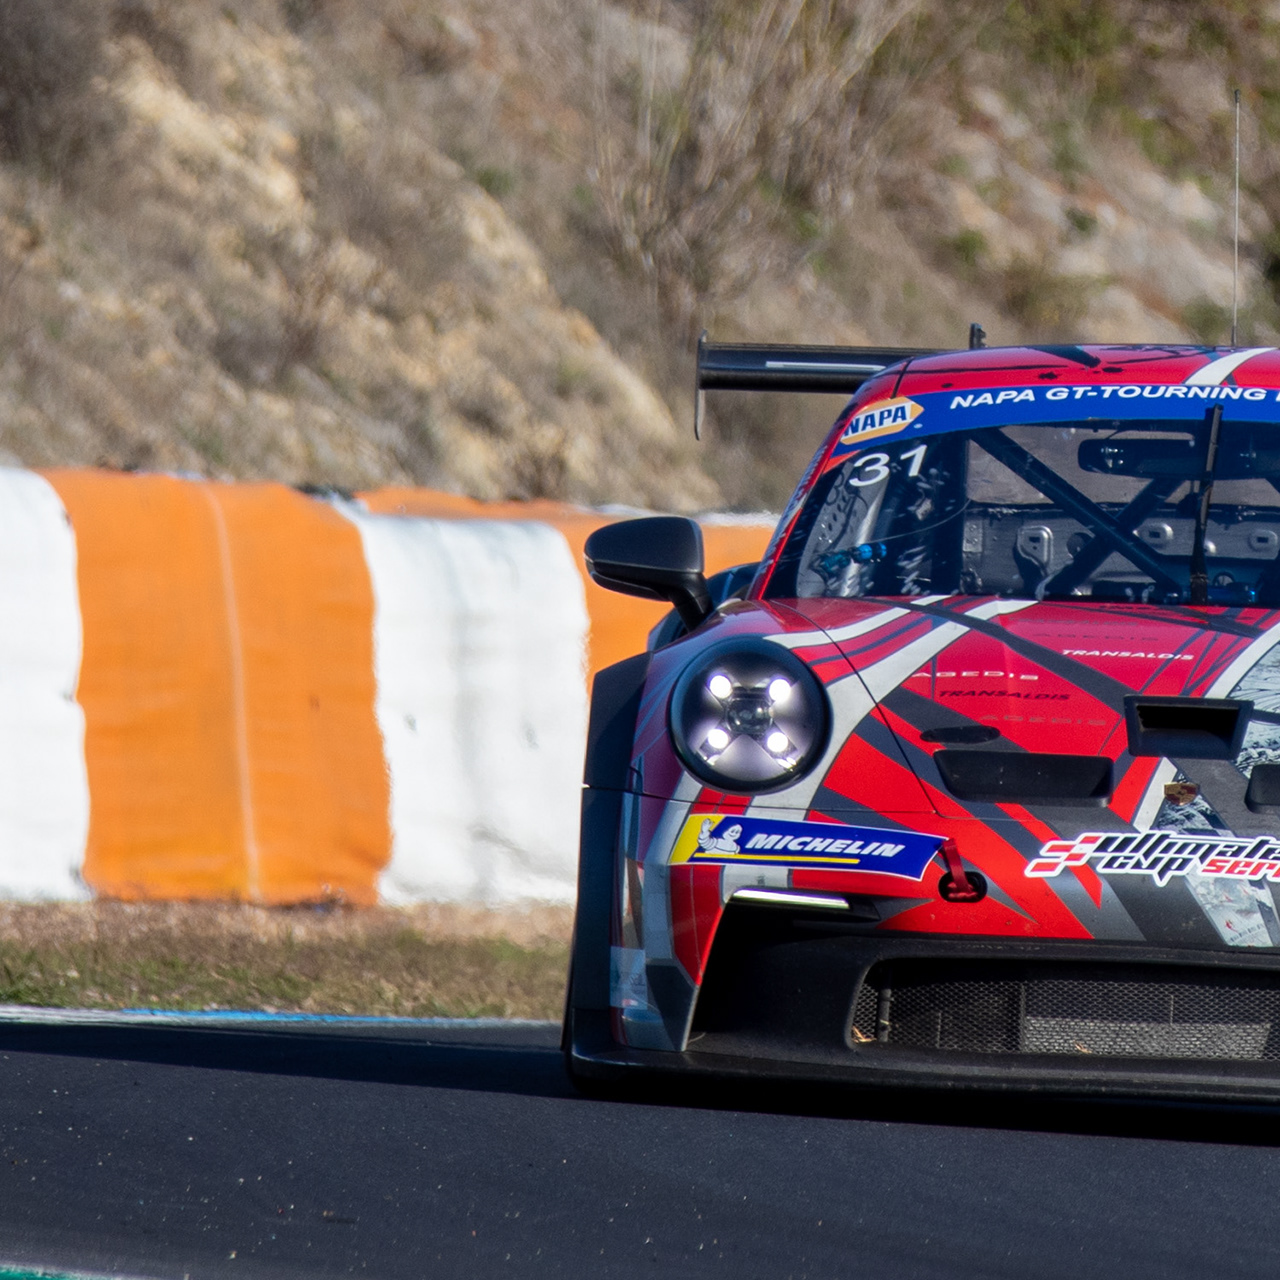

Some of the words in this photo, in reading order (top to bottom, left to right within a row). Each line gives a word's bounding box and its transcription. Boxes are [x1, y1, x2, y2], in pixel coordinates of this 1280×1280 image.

[950, 389, 1035, 410] NAPA
[1045, 385, 1268, 401] GT-TOURNING
[845, 405, 907, 437] NAPA
[849, 444, 928, 488] 31
[1062, 648, 1195, 661] TRANSALDIS
[939, 689, 1071, 701] TRANSALDIS
[745, 833, 906, 858] MICHELIN
